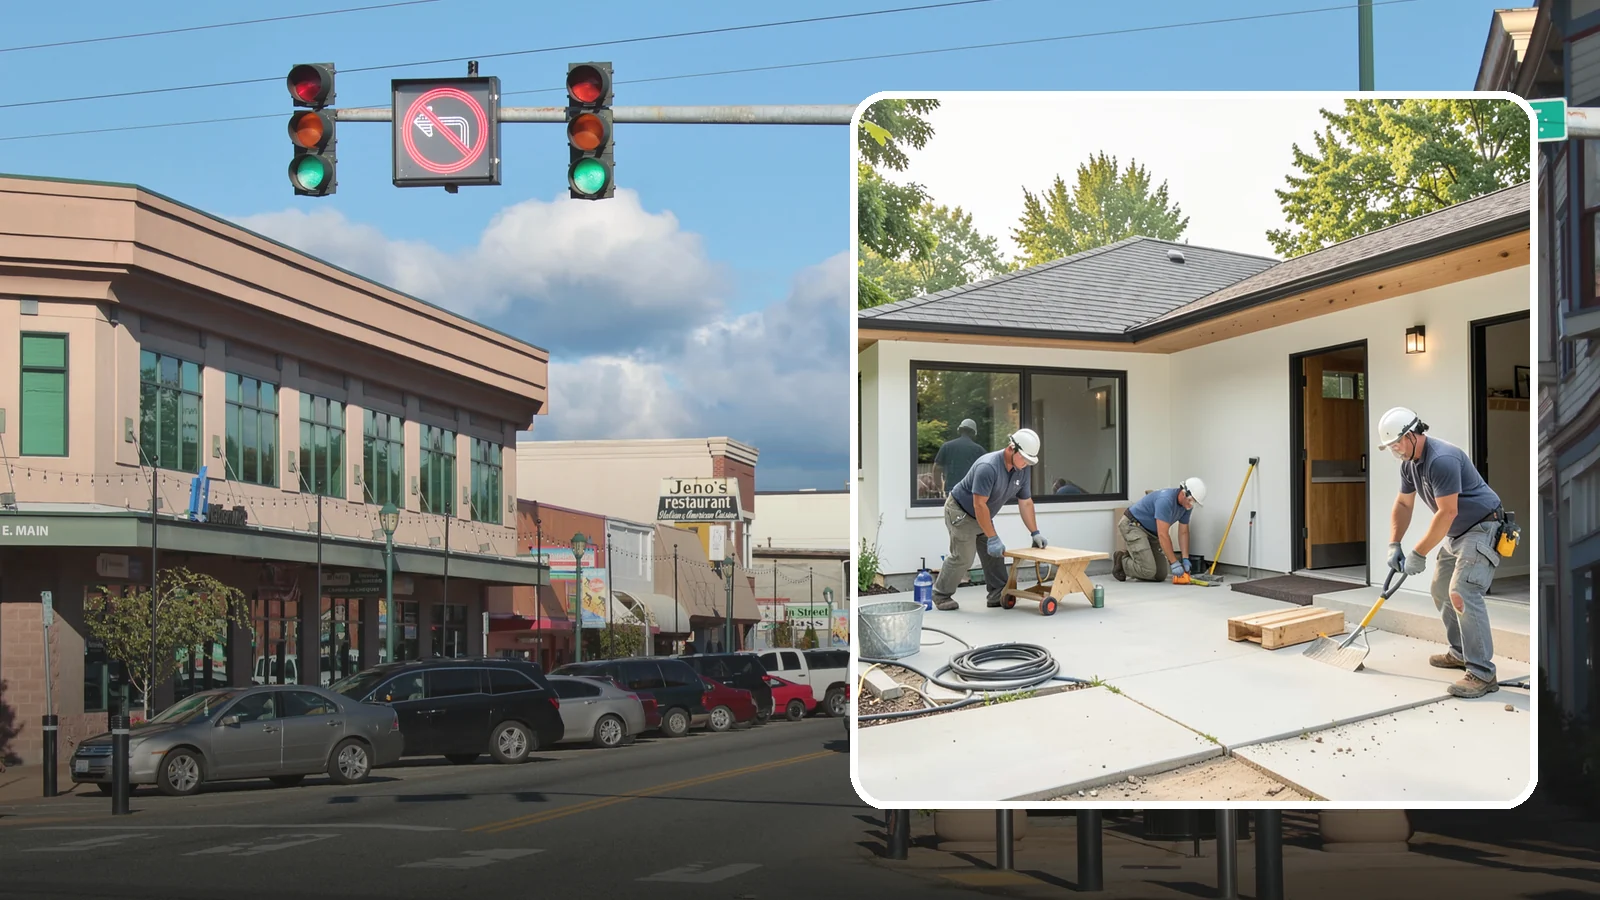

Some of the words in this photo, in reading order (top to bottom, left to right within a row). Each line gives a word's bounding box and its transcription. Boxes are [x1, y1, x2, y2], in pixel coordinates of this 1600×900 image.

[669, 480, 728, 494] Jeno's
[665, 496, 731, 509] restaurant
[686, 510, 715, 520] American
[715, 509, 737, 519] Cuisine
[2, 525, 13, 536] E.
[15, 525, 49, 537] MAIN
[797, 608, 828, 617] Street
